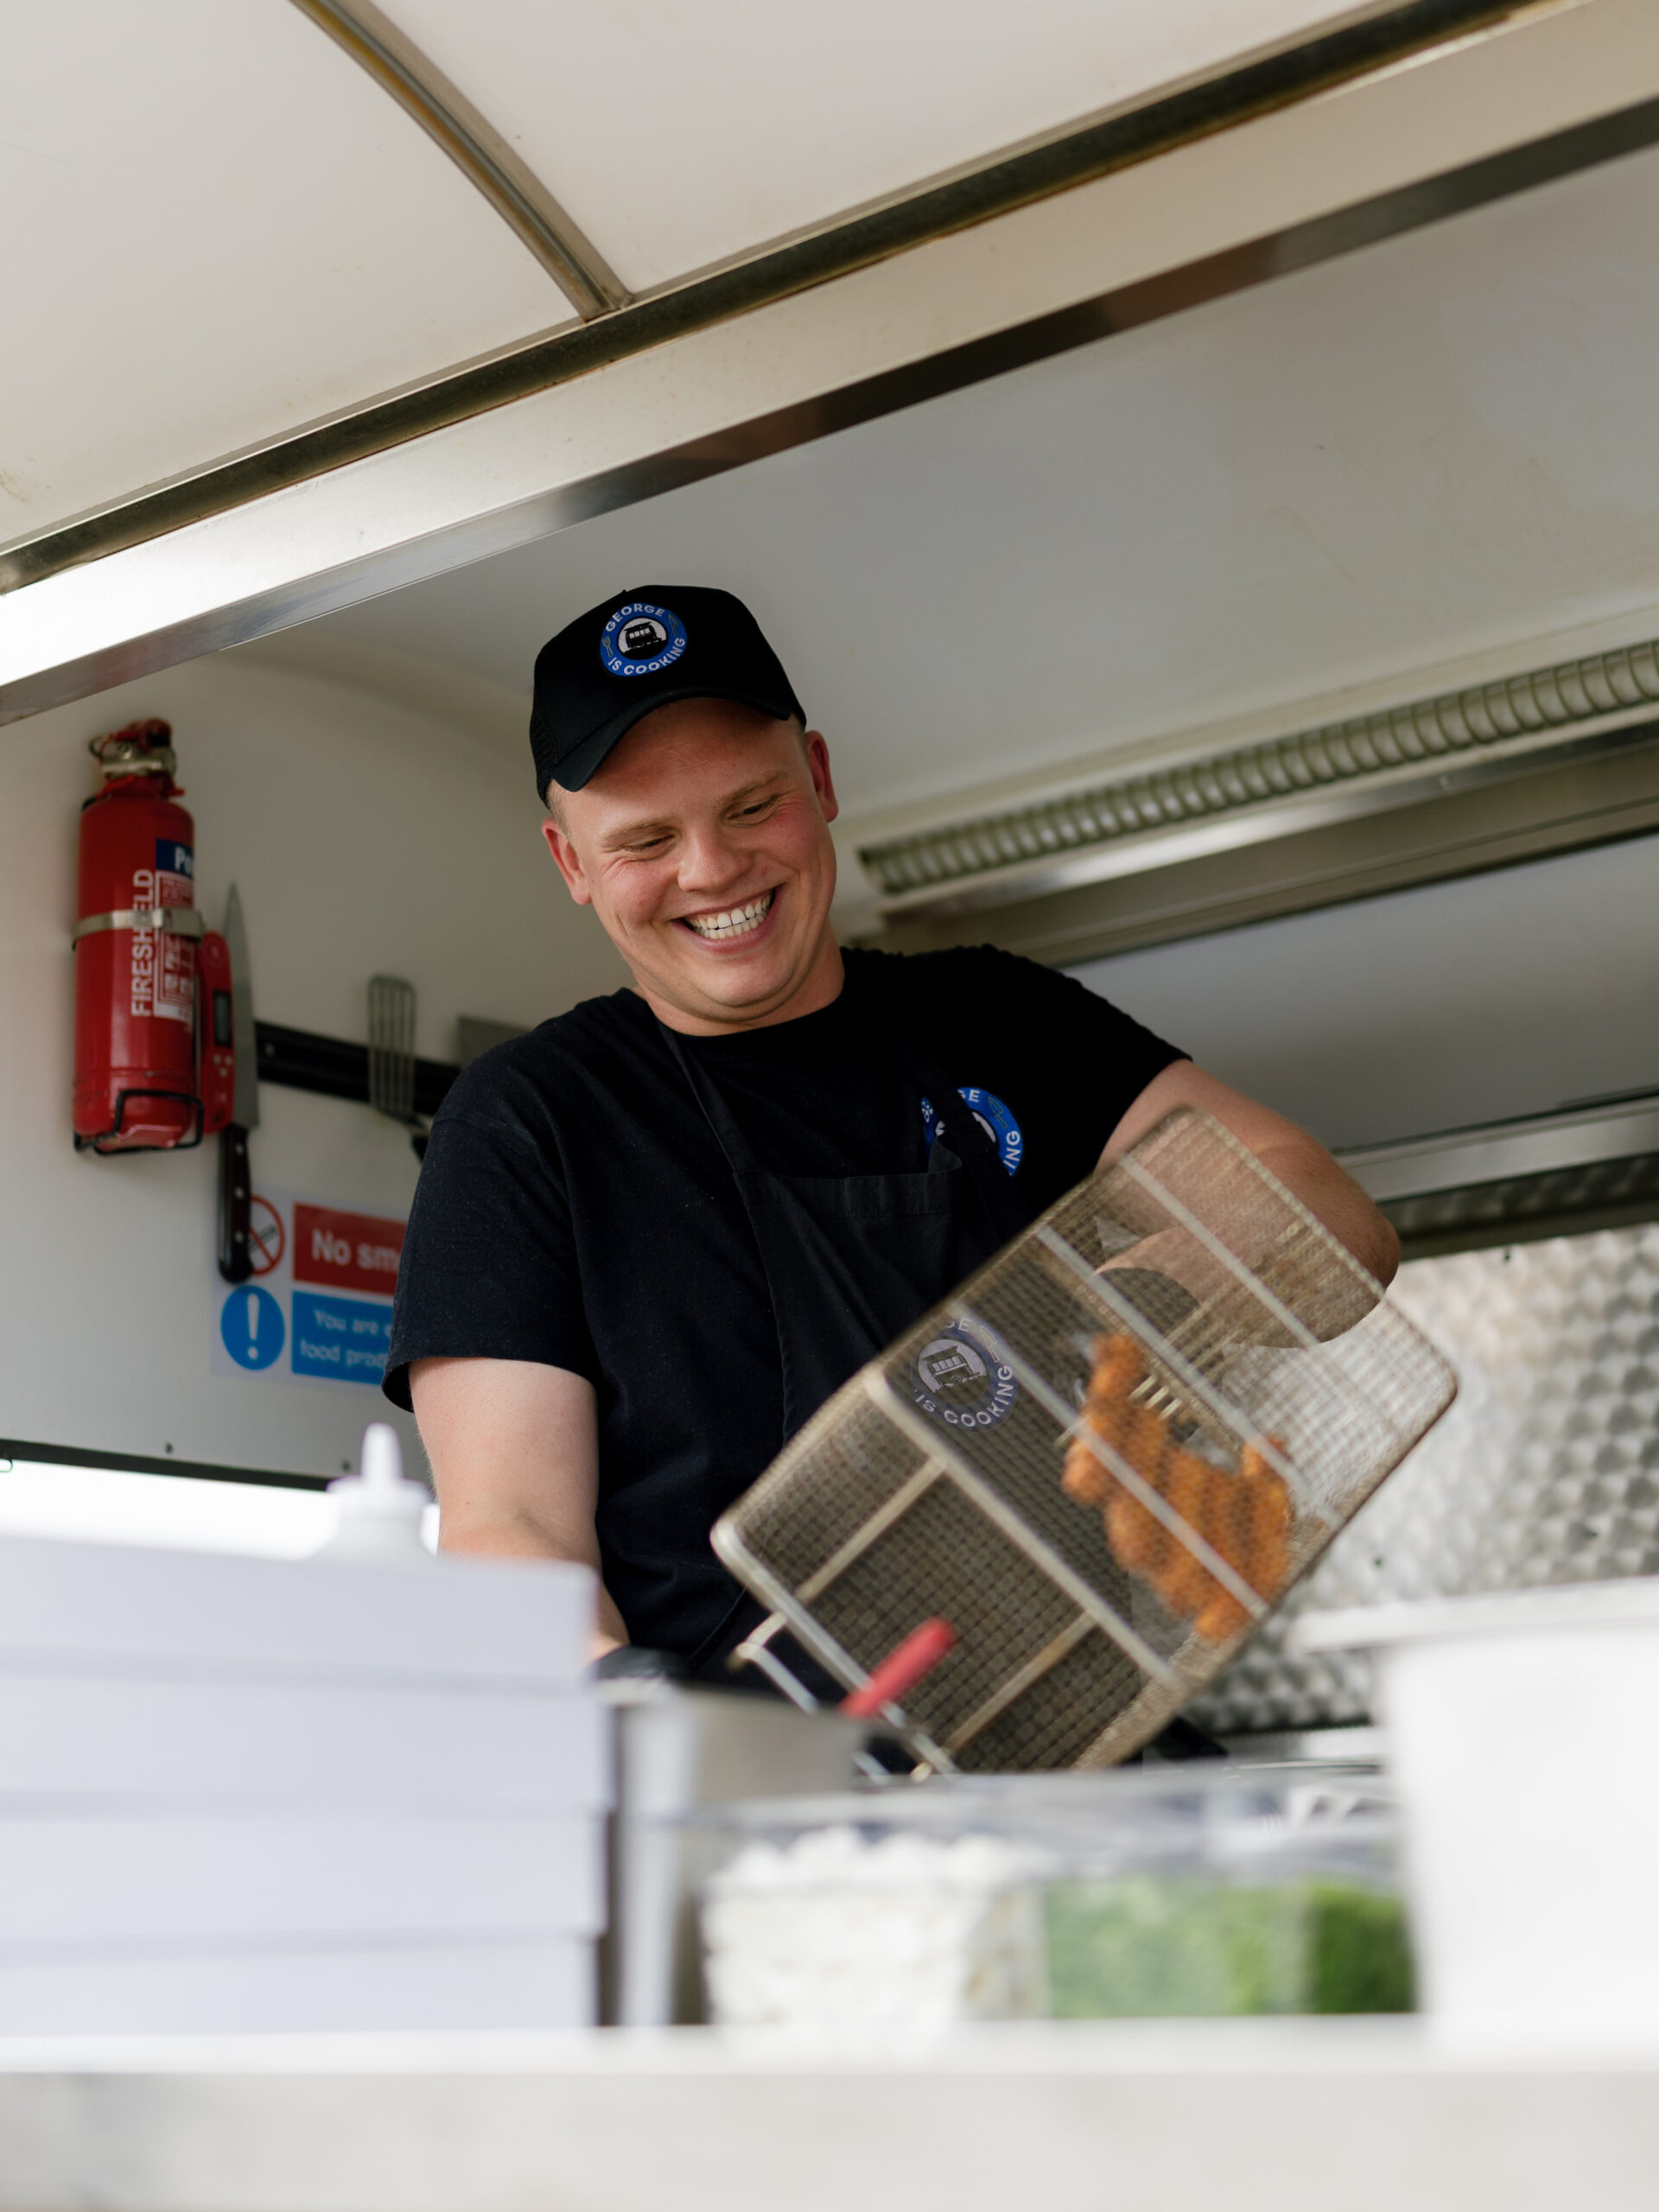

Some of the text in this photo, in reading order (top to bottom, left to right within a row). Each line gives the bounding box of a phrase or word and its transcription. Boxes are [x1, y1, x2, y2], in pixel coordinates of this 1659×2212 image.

[606, 603, 665, 632] GEORGE
[608, 638, 685, 675] IS COOKING
[131, 869, 154, 1016] FIRESHLD
[312, 1228, 351, 1265] No
[314, 1308, 346, 1331] You
[352, 1319, 378, 1336] are
[301, 1338, 340, 1363] food
[916, 1365, 1014, 1427] IS COOKING
